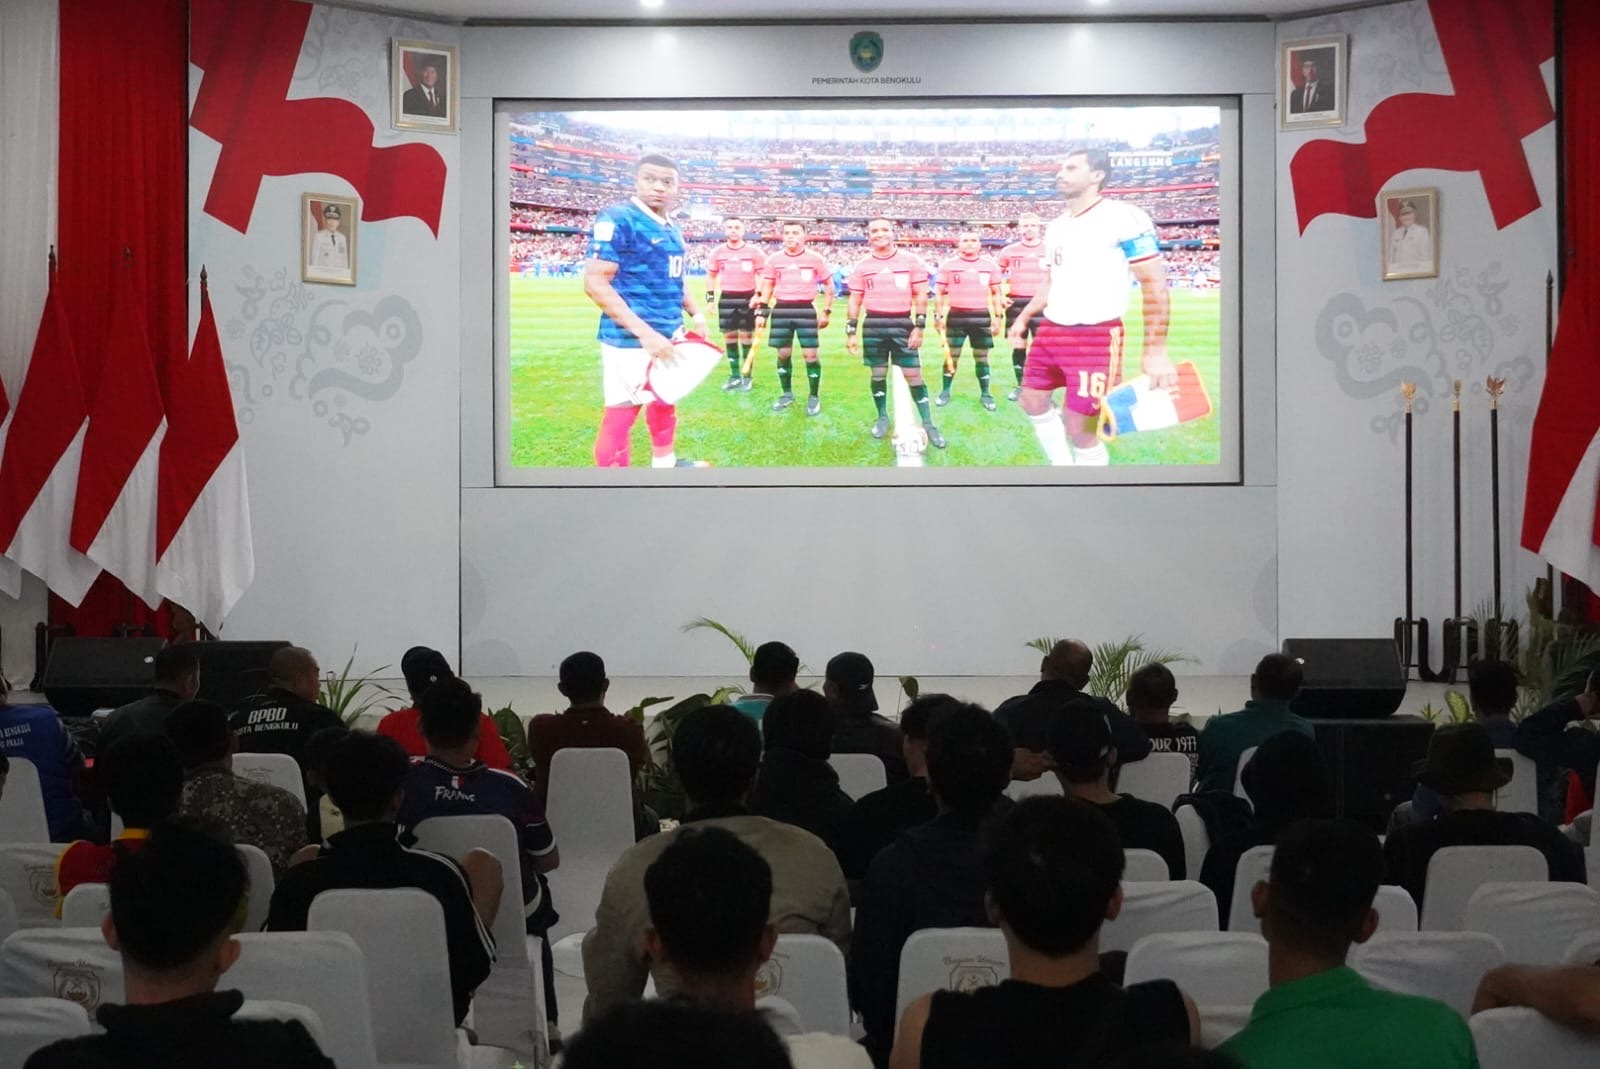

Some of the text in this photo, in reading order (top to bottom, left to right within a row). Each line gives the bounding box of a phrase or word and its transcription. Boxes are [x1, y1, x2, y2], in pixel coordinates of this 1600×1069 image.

[812, 77, 858, 85] PEMERINTAH
[880, 76, 921, 84] BENGKULU
[668, 255, 683, 278] 10
[1077, 370, 1107, 398] 16
[247, 707, 288, 725] BPBD
[1175, 735, 1197, 752] 1977
